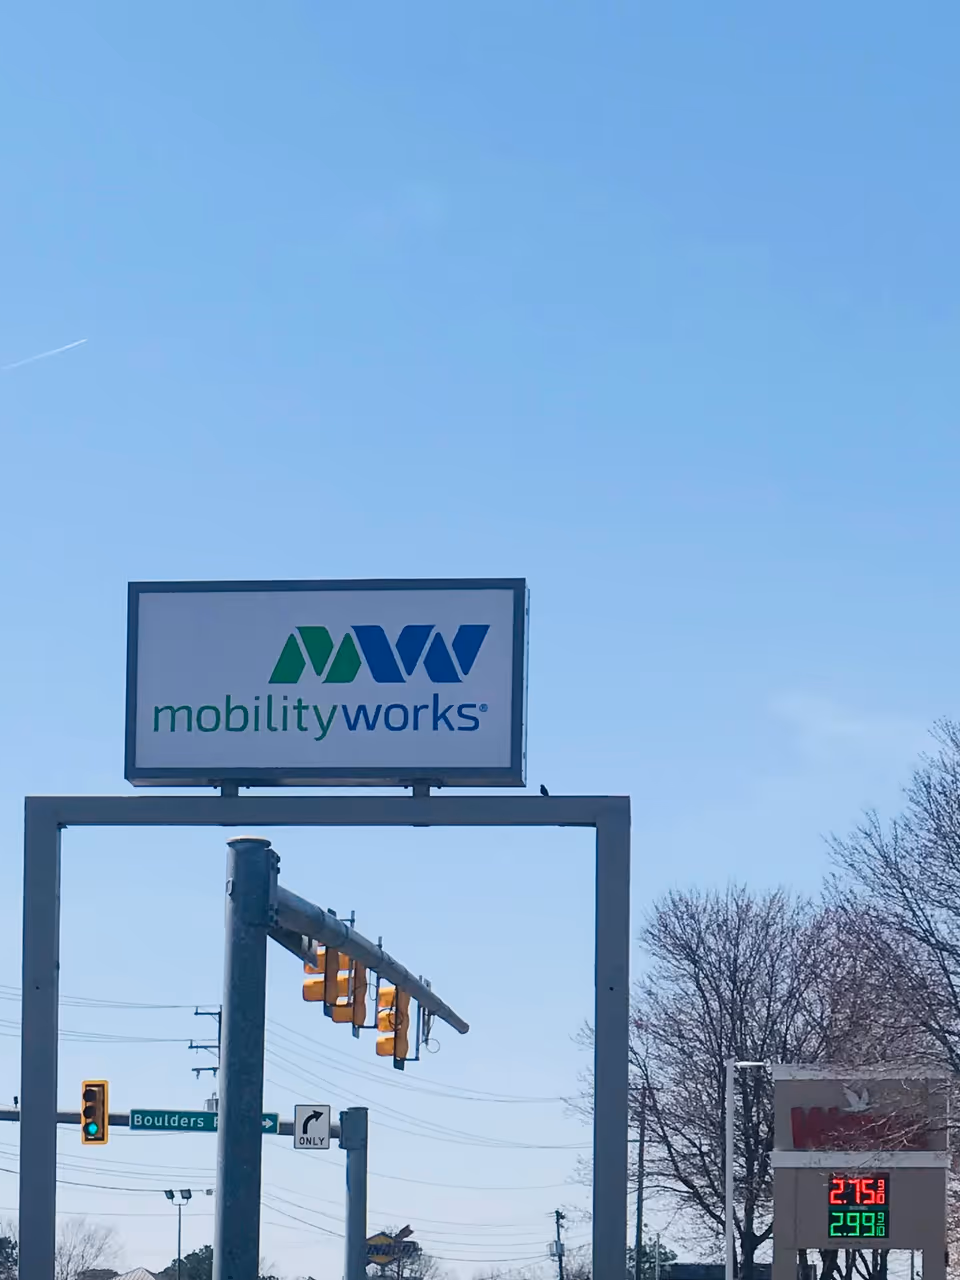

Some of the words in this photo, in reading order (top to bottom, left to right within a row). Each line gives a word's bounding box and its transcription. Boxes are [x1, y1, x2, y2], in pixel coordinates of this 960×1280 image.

[134, 1114, 204, 1127] Boulders
[299, 1136, 325, 1146] ONLY
[829, 1211, 876, 1237] 2.99
